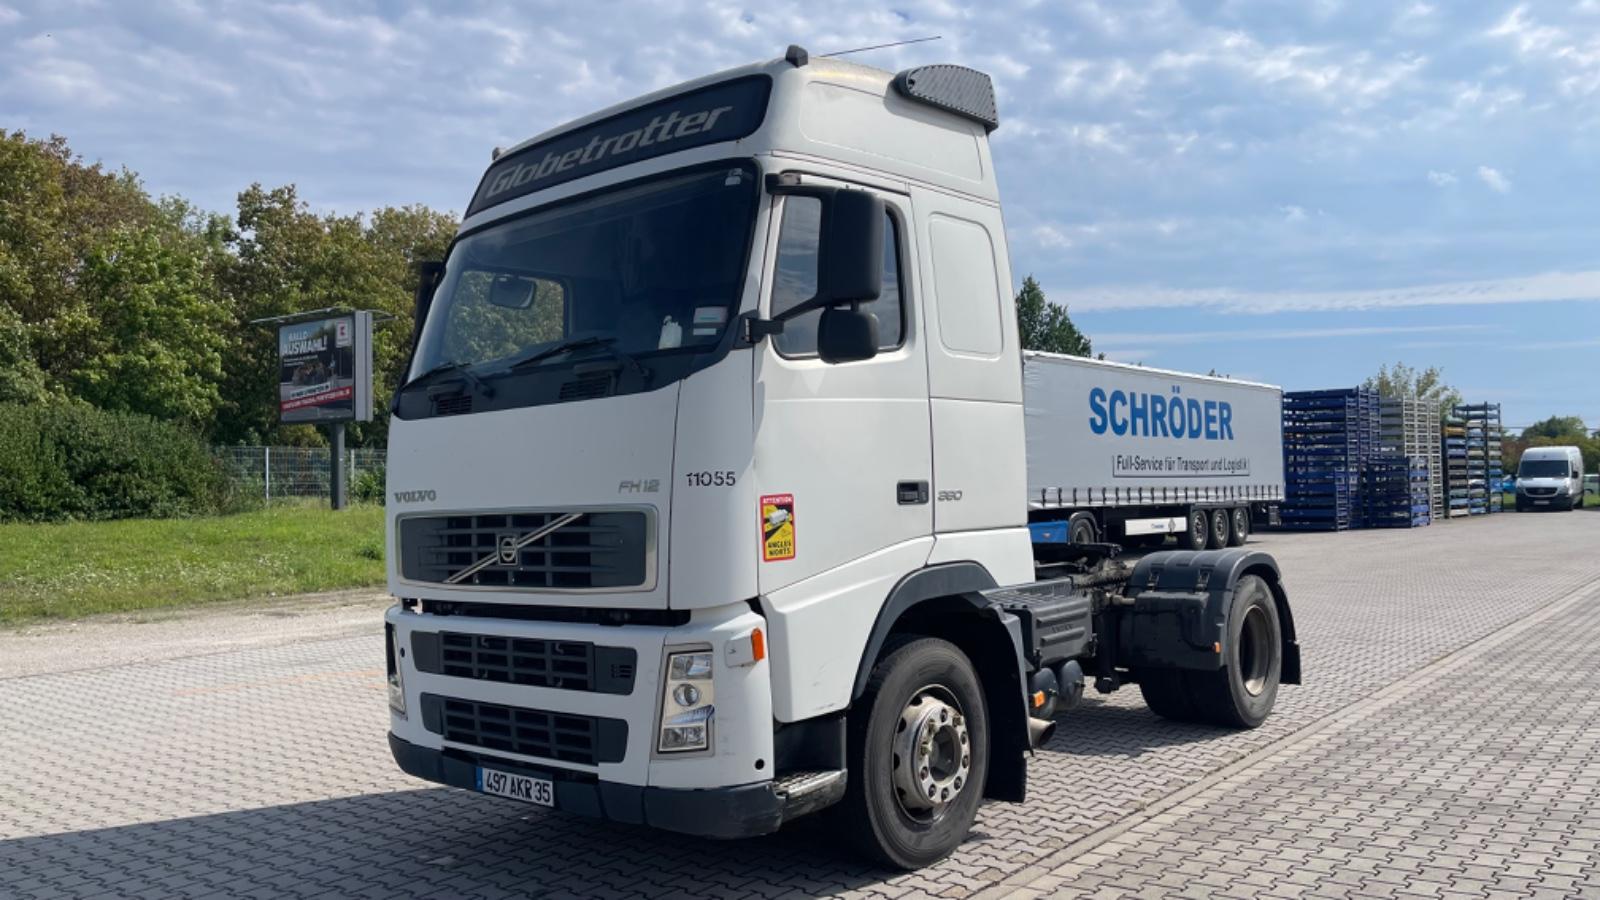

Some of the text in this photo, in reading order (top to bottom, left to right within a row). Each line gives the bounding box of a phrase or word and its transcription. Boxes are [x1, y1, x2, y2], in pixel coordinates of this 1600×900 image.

[486, 105, 733, 199] Globetrotter
[1089, 386, 1233, 440] SCHRÖDER
[1117, 455, 1247, 474] Full-Service für Transport und Logistik
[686, 471, 736, 487] 11055
[394, 489, 436, 503] VOLVO
[486, 771, 552, 803] 497 AKR 35
